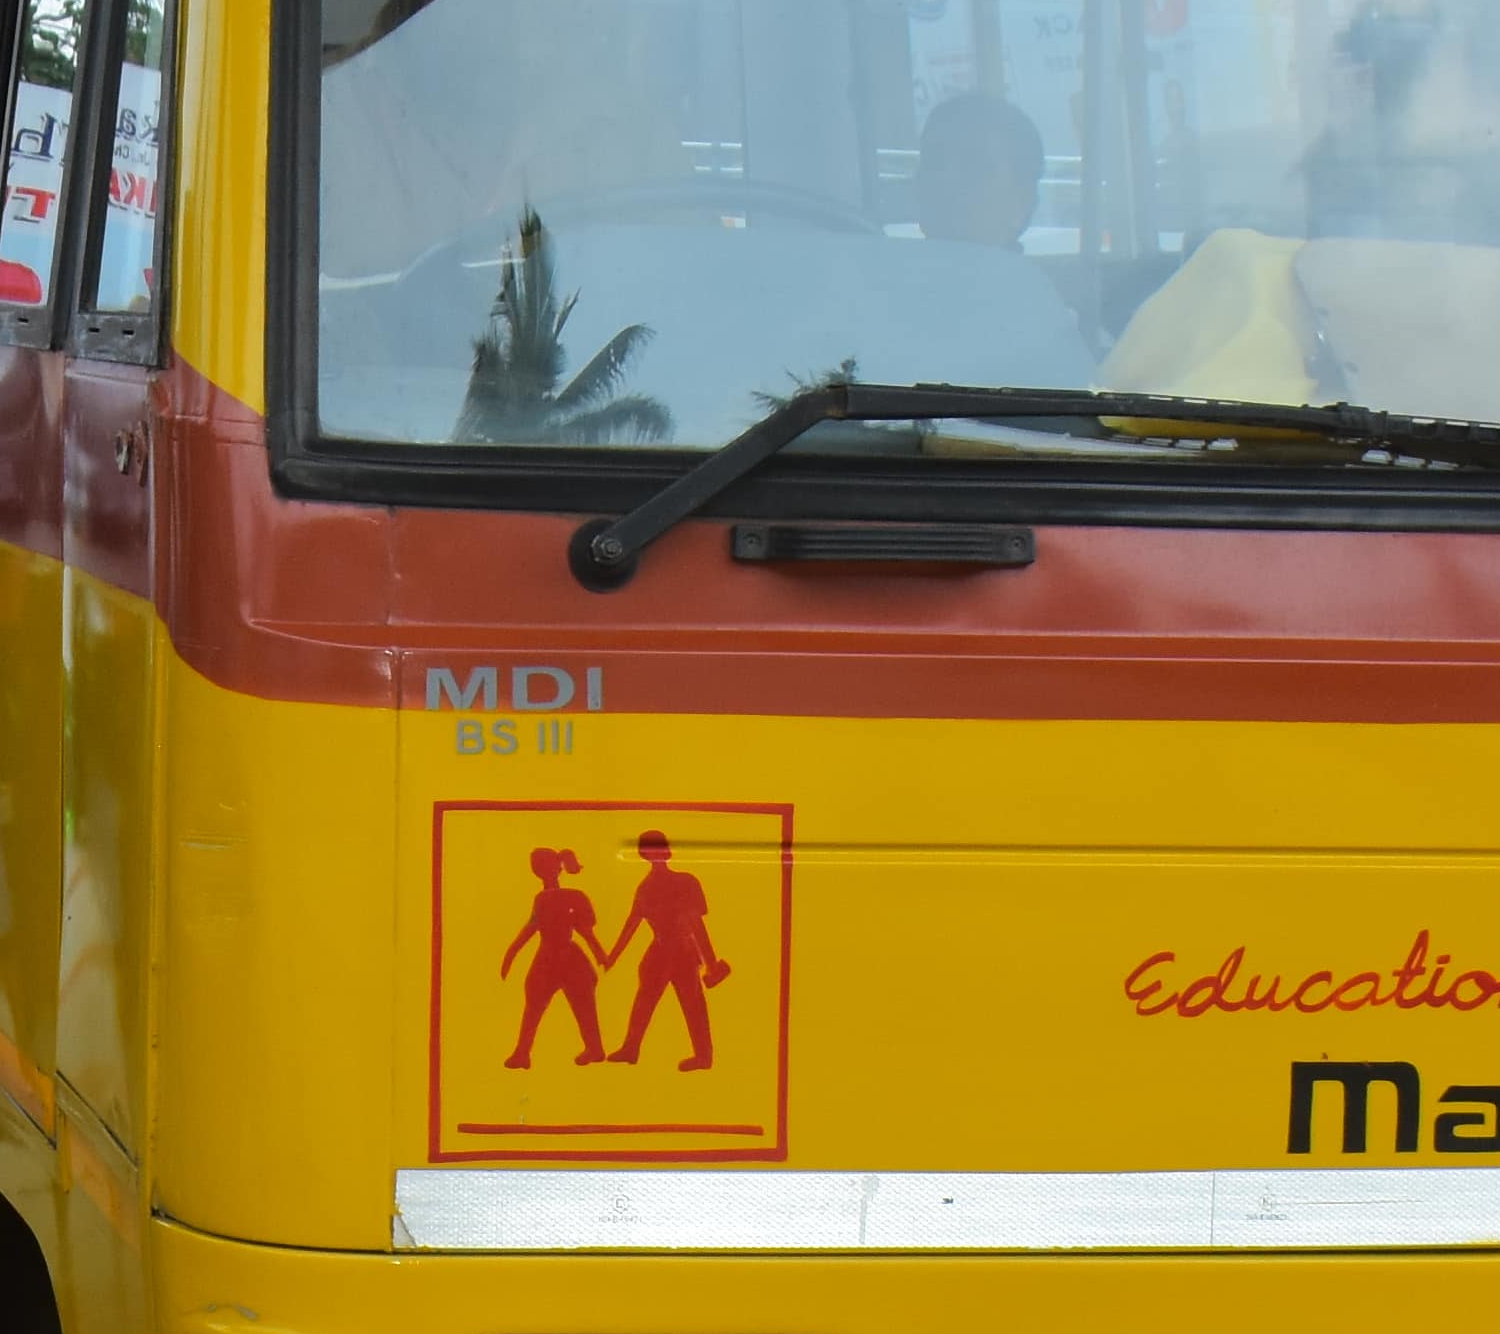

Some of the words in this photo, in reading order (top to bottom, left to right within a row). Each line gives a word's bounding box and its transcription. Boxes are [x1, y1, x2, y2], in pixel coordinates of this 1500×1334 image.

[424, 665, 604, 713] MDI
[455, 719, 519, 756] BS
[537, 720, 574, 755] III
